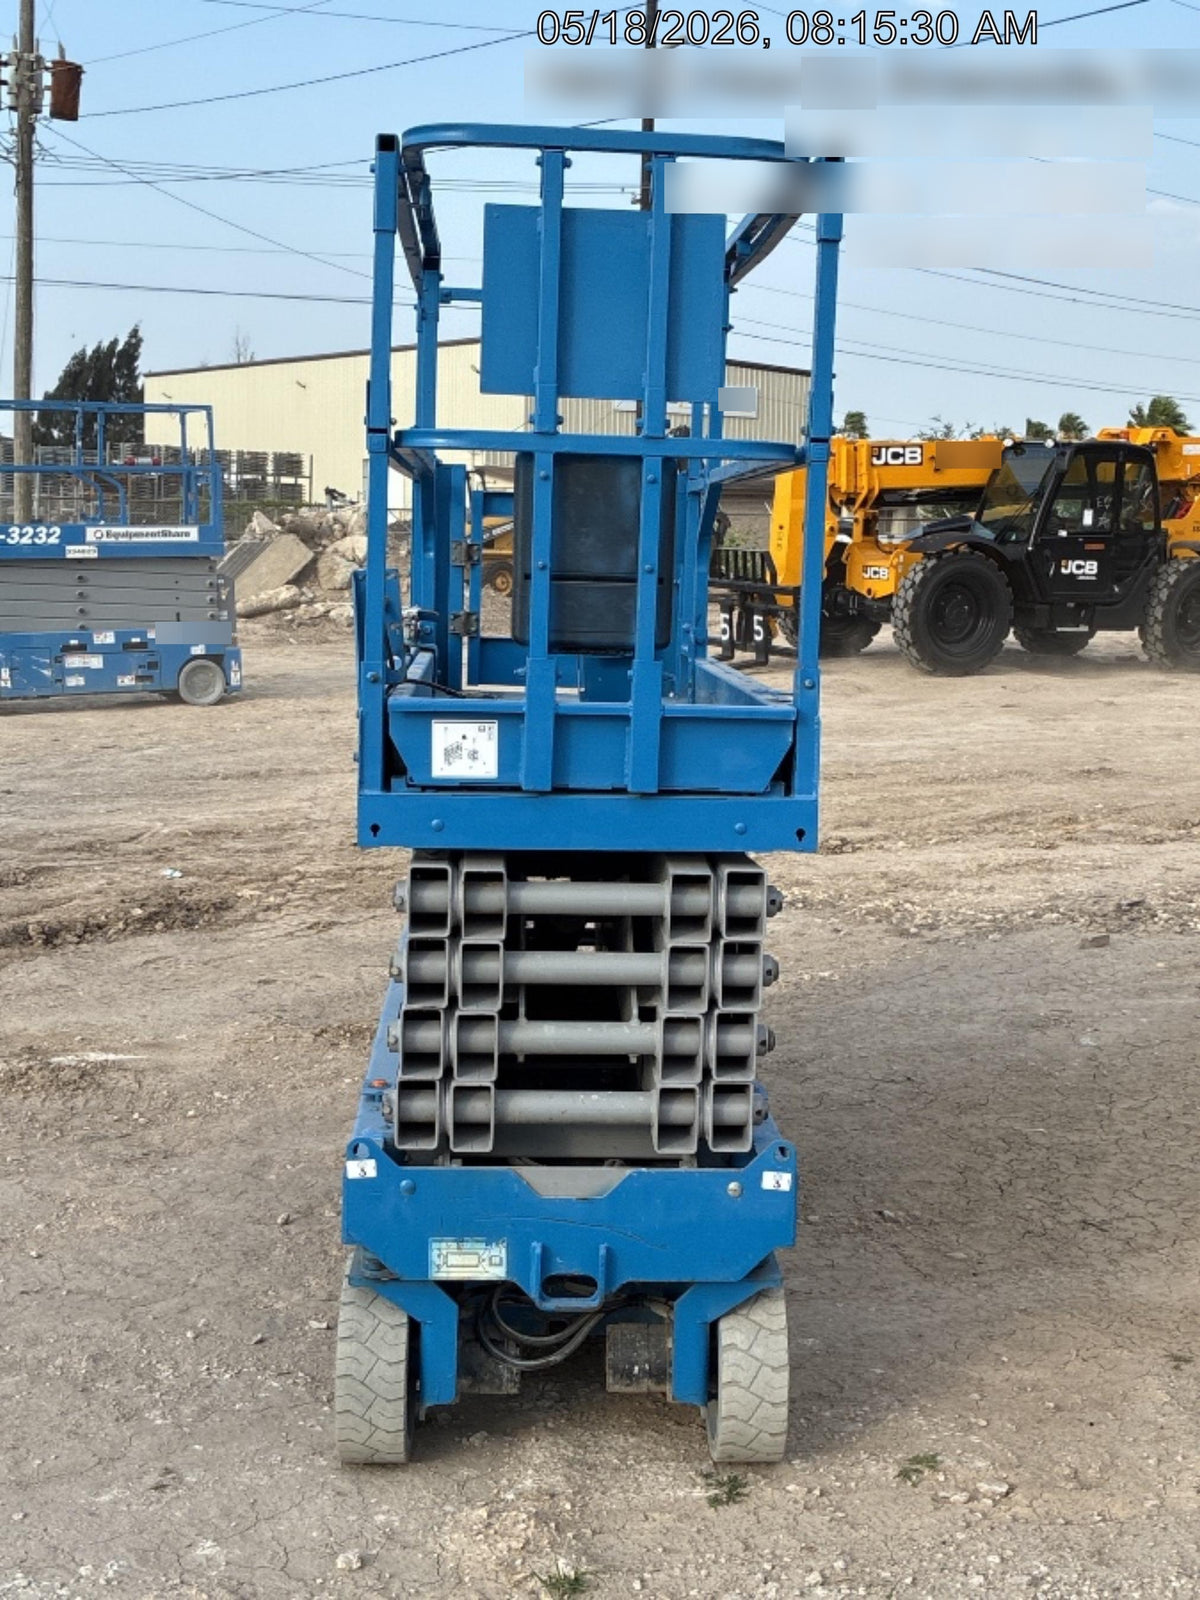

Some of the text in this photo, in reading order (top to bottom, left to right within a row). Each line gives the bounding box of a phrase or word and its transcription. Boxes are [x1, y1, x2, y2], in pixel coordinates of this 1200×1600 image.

[872, 447, 922, 465] JCB
[106, 529, 191, 540] EquipmentShare
[863, 566, 888, 579] JCB
[1061, 560, 1098, 575] JCB
[720, 613, 730, 640] 5
[753, 615, 764, 640] 5
